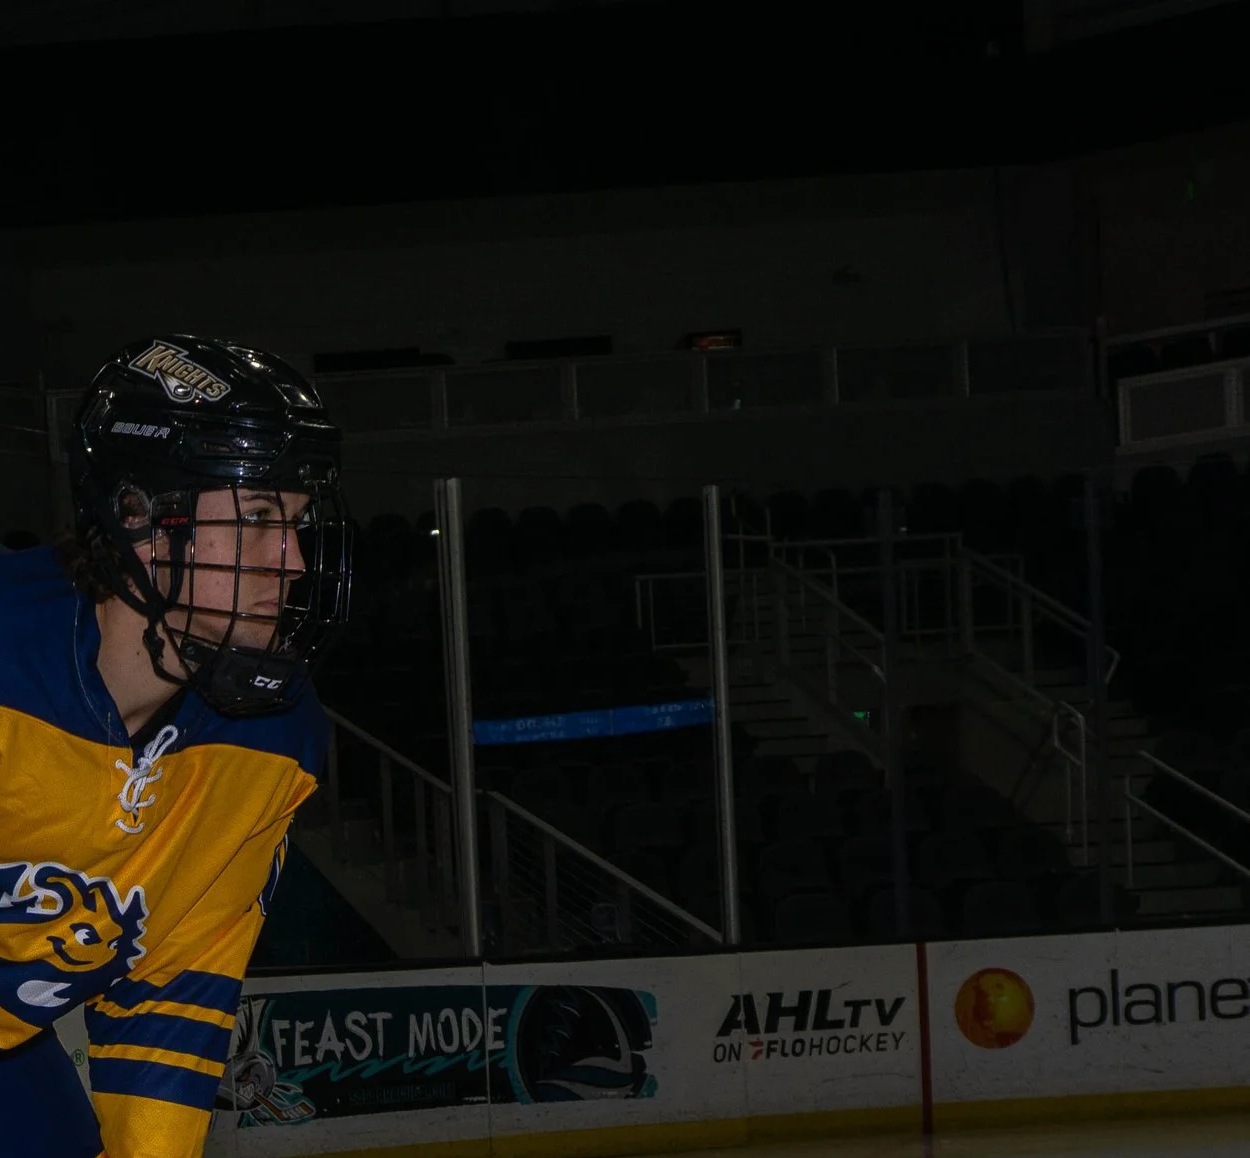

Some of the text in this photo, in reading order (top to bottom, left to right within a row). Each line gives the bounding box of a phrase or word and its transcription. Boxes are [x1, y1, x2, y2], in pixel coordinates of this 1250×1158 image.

[135, 344, 227, 397] KNIGHTS
[1069, 969, 1250, 1045] plane
[271, 1006, 510, 1067] FEAST MODE
[713, 1043, 743, 1064] ON
